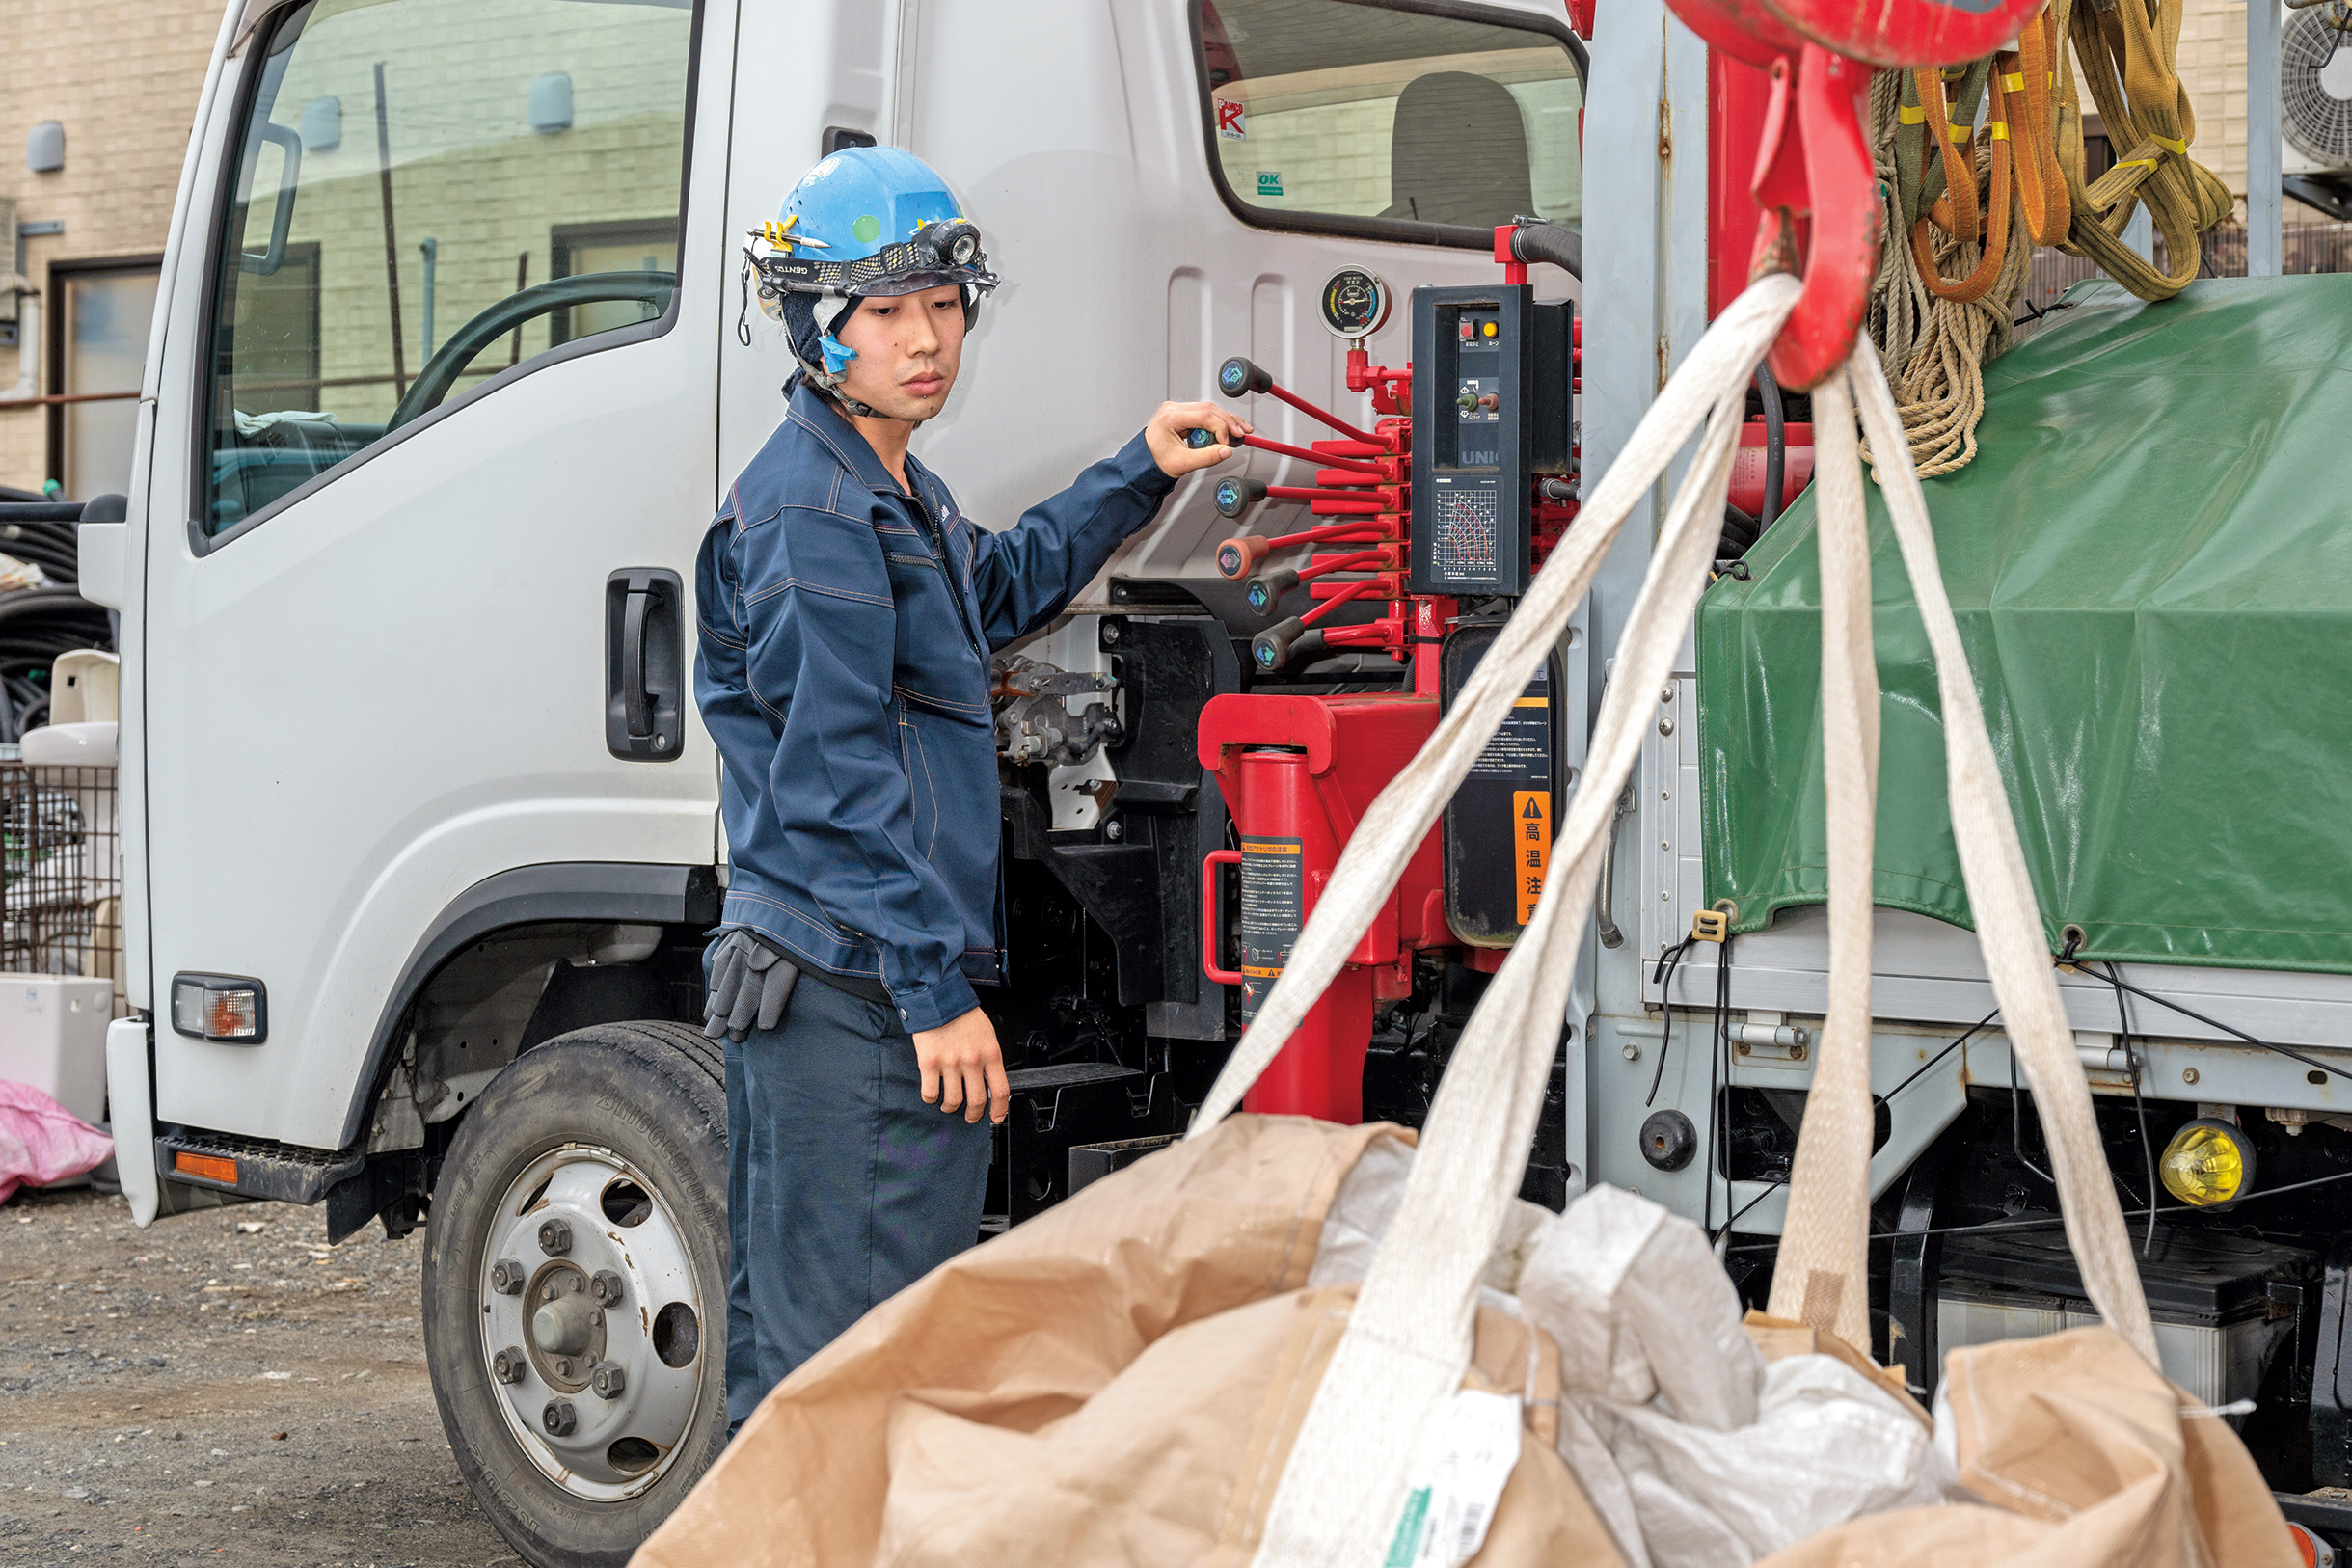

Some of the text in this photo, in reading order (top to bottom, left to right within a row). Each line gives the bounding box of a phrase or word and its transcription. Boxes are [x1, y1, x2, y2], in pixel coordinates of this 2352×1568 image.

[1218, 99, 1244, 114] PAMCO
[1258, 174, 1280, 185] OK
[774, 264, 809, 275] GENTOS
[1462, 450, 1499, 464] UNI
[595, 1084, 722, 1238] BRIDGESTONE
